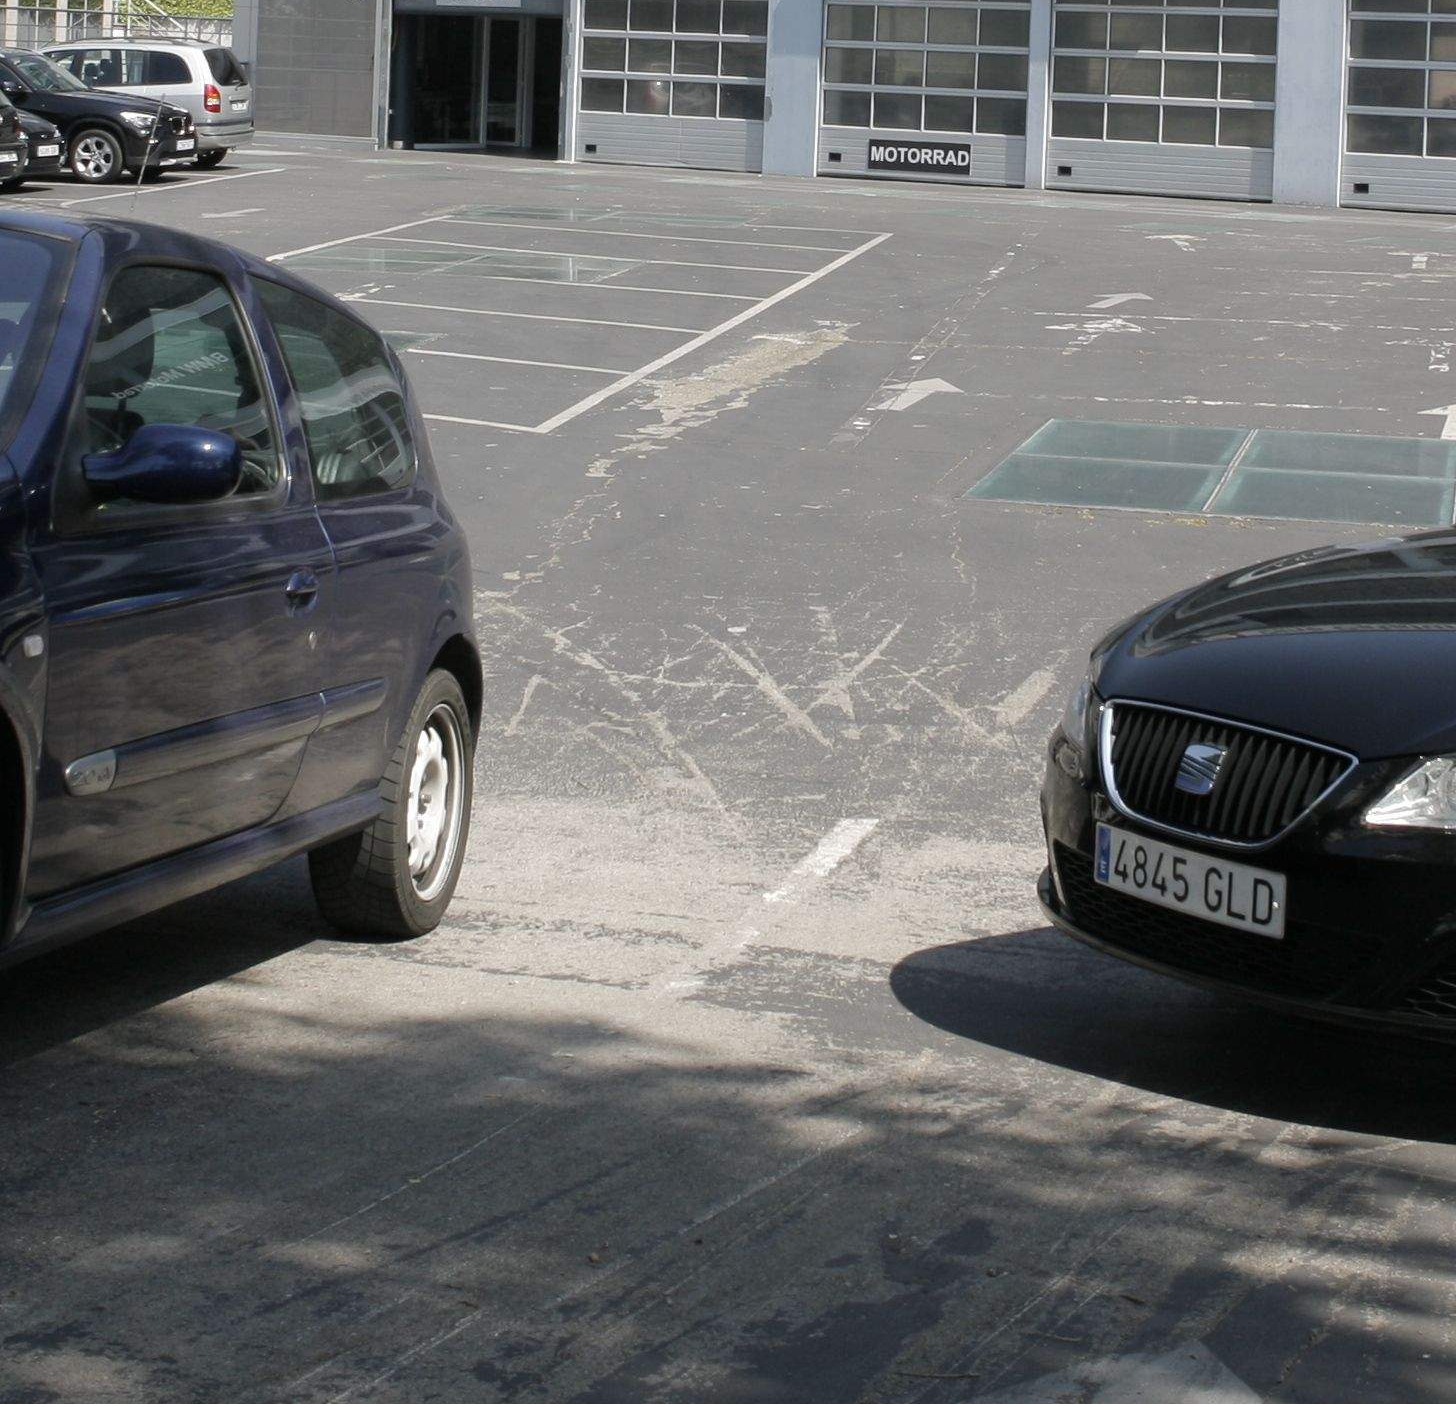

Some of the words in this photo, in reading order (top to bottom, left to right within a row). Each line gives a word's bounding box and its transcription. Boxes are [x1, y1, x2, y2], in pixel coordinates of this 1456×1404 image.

[870, 145, 970, 167] MOTORRAD
[1113, 838, 1190, 903] 4845
[1203, 866, 1274, 926] GLD
